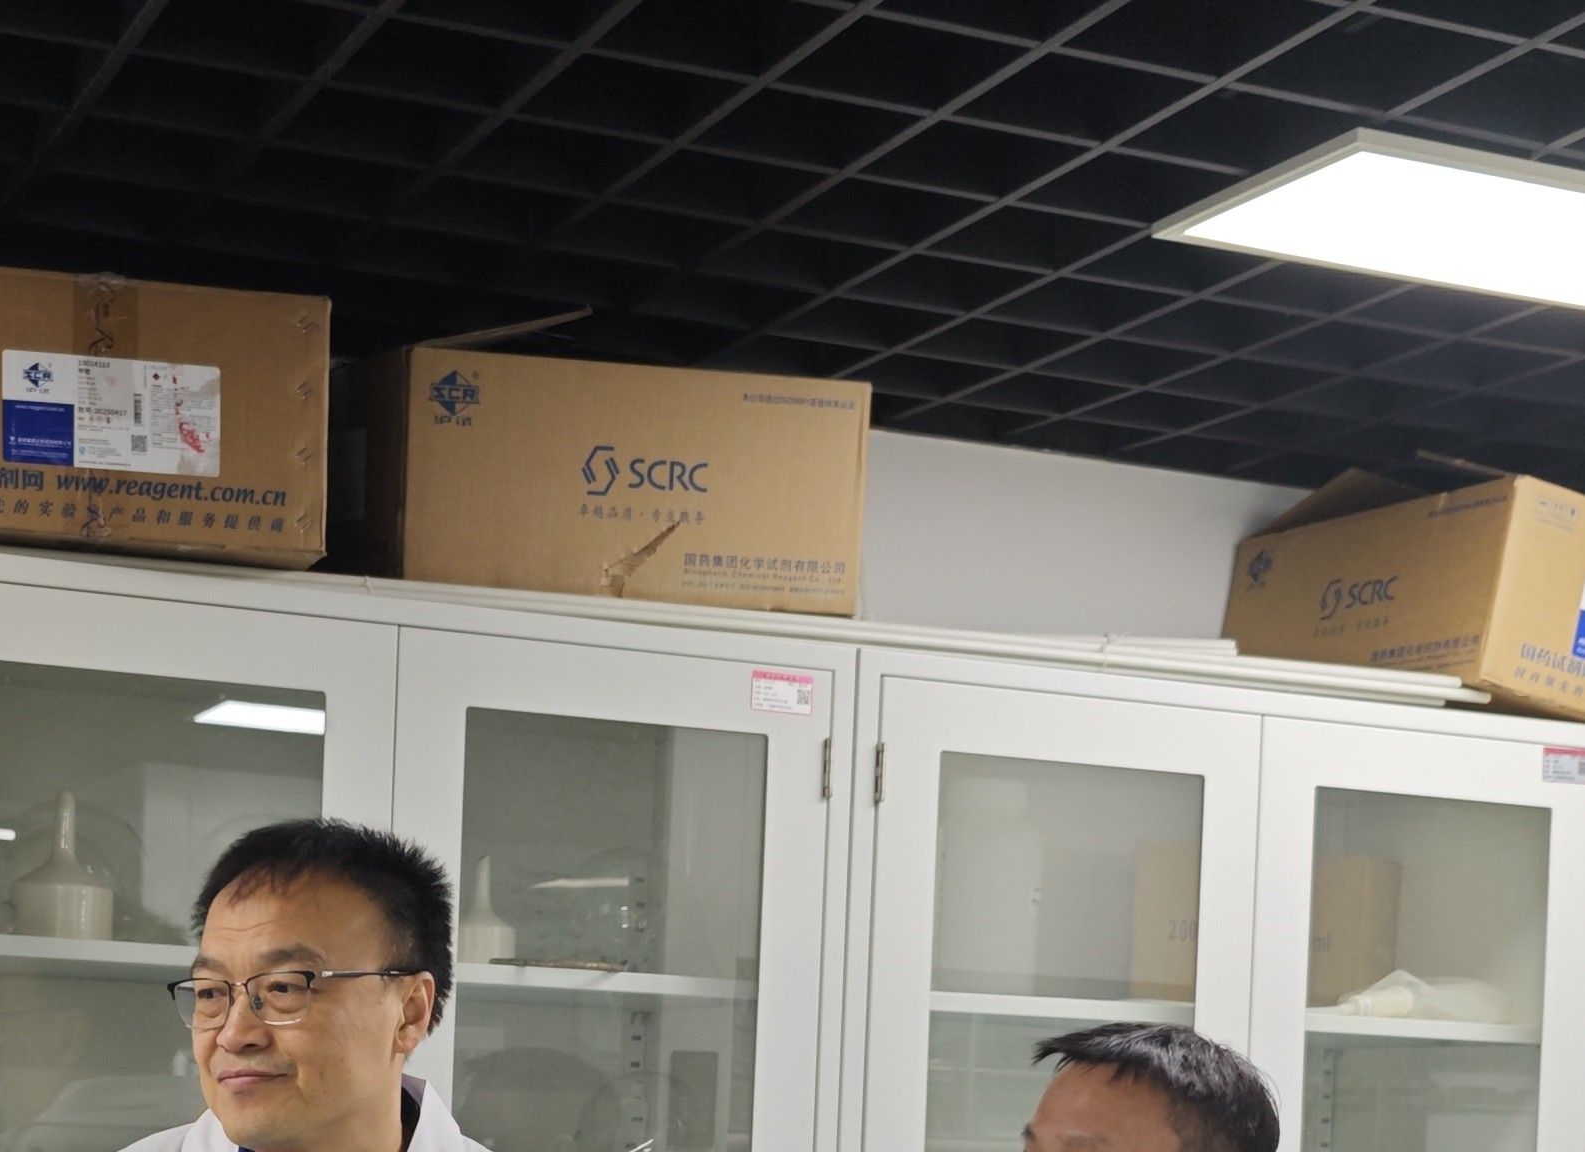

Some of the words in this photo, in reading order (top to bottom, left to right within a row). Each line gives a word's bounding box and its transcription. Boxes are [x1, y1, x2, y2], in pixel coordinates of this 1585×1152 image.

[56, 473, 287, 507] www.reagent.com.cn
[628, 458, 708, 493] SCRC
[1345, 575, 1398, 609] SCRC
[1520, 641, 1585, 678] 国药试剂
